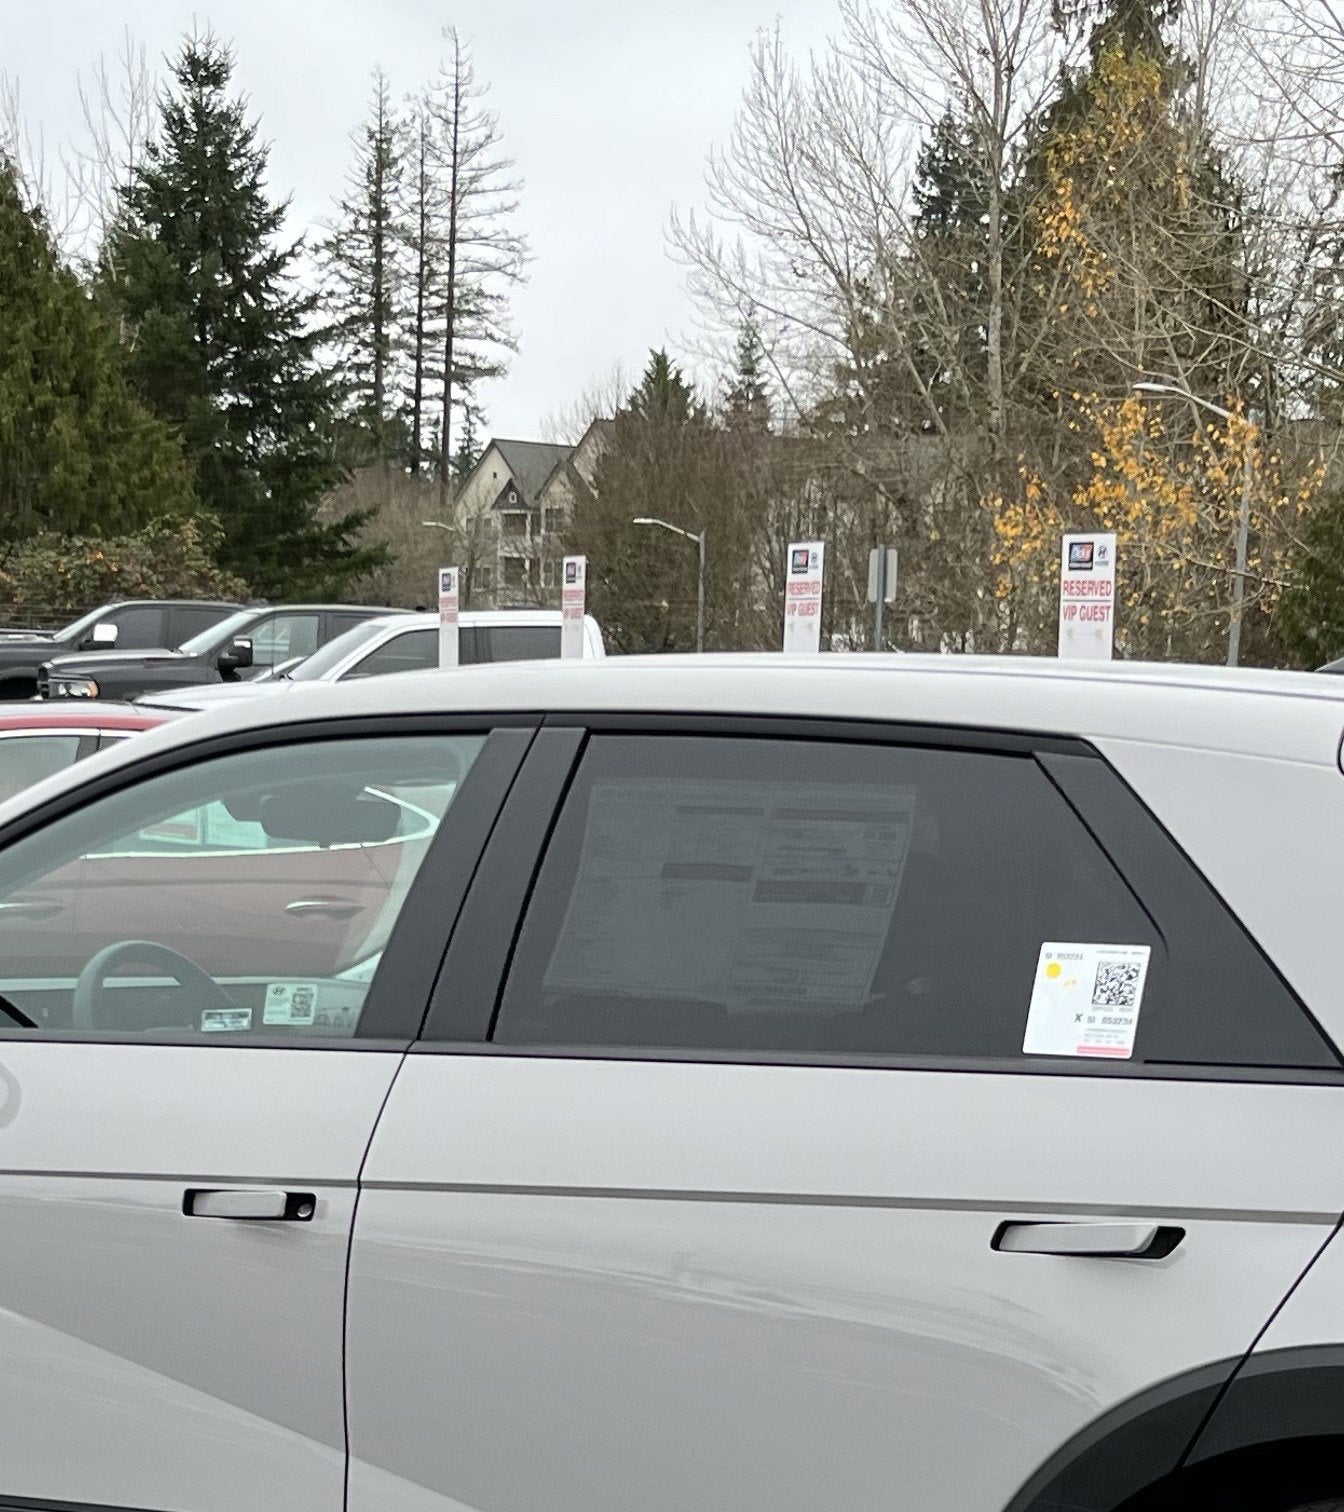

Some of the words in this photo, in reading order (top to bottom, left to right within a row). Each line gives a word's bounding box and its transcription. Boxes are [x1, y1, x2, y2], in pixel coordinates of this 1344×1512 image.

[1063, 580, 1112, 597] RESERVED
[1063, 605, 1077, 621] VIP
[1079, 605, 1111, 622] GUEST
